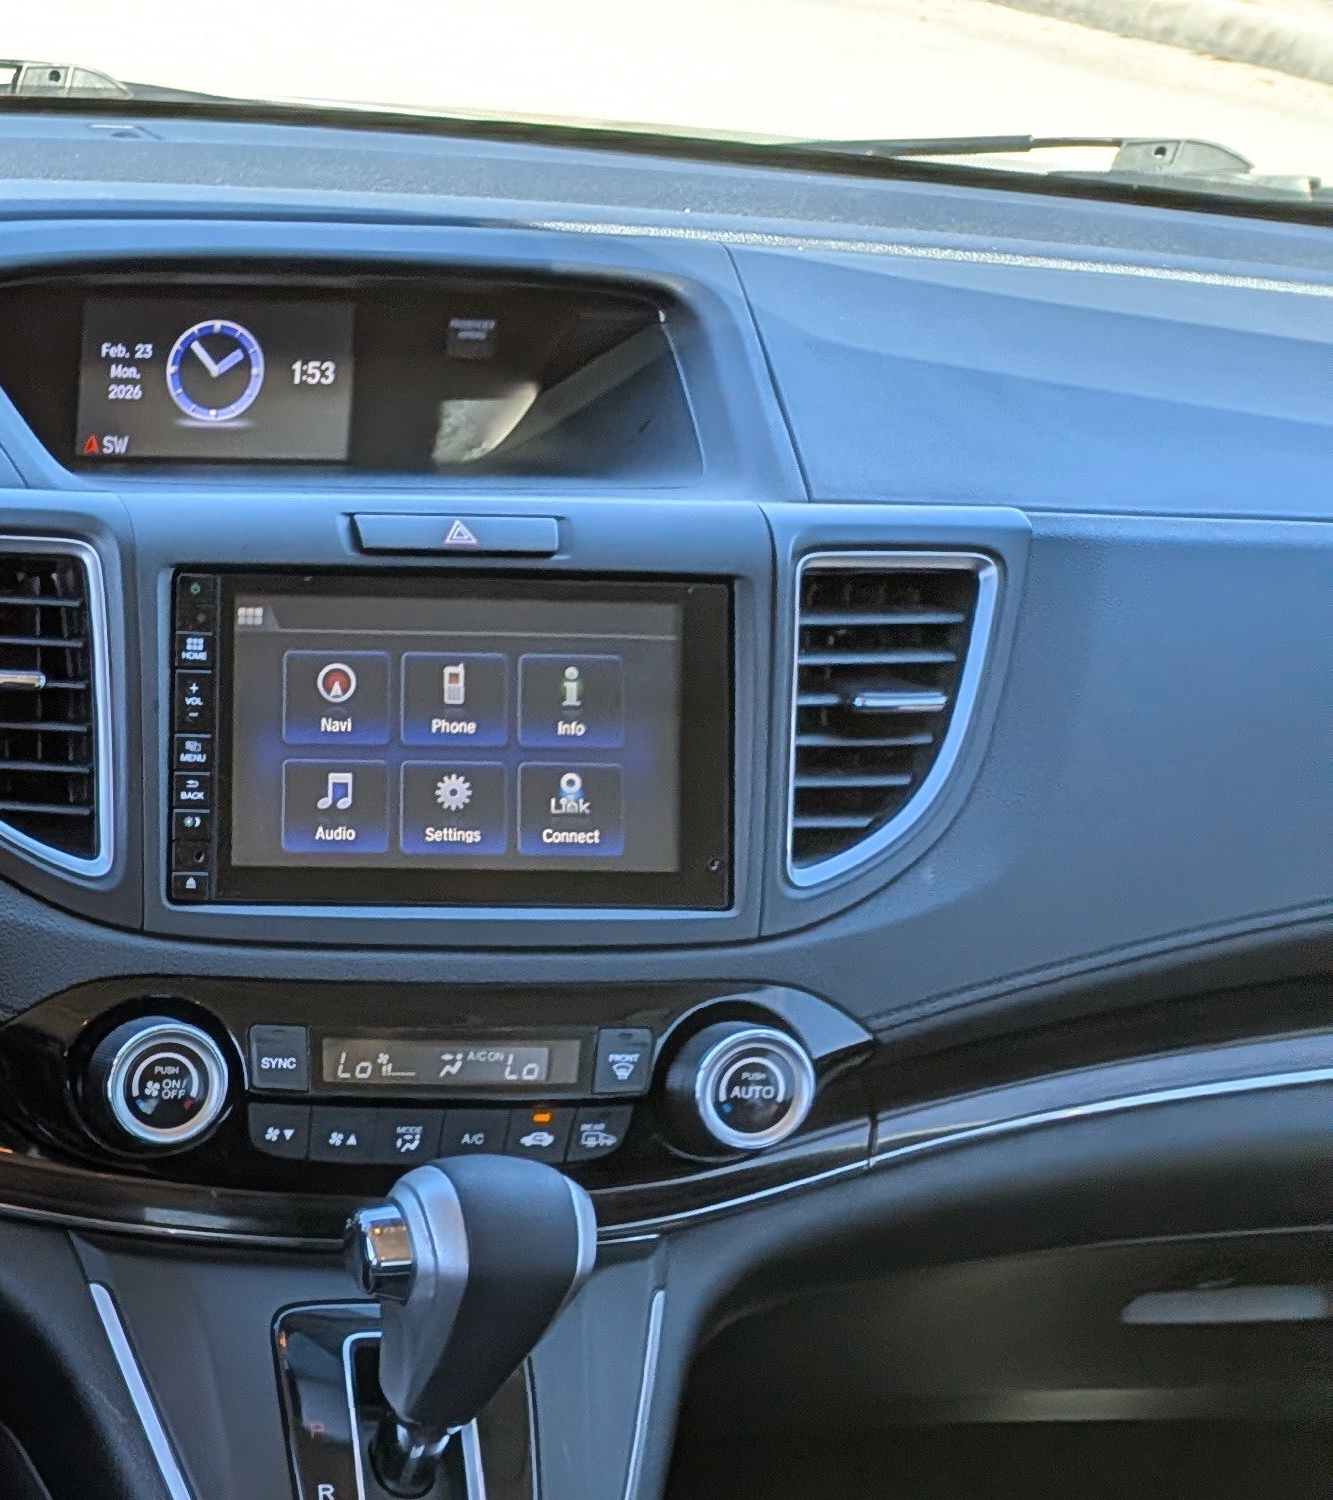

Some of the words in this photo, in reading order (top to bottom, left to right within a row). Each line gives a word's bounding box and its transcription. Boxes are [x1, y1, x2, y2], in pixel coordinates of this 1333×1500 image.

[101, 342, 130, 359] Feb.
[134, 343, 153, 359] 23
[110, 364, 141, 379] Mon.
[291, 361, 335, 385] 1:53
[108, 384, 142, 400] 2026
[102, 435, 129, 454] SW
[182, 651, 207, 660] HOME
[185, 697, 203, 706] VOL
[320, 717, 352, 734] Navi
[431, 718, 476, 735] Phone
[557, 720, 586, 737] Info
[180, 753, 207, 762] MENU
[180, 791, 205, 800] BACK
[550, 796, 590, 816] Link
[315, 826, 356, 843] Audio
[425, 826, 481, 845] Settings
[542, 829, 600, 845] Connect
[261, 1057, 296, 1069] SYNC
[608, 1053, 641, 1063] FRONT
[154, 1066, 179, 1075] PUSH
[741, 1072, 767, 1080] PUSH
[162, 1089, 186, 1100] OFF
[730, 1086, 775, 1099] AUTO
[461, 1133, 484, 1145] A/C
[310, 1422, 325, 1438] P
